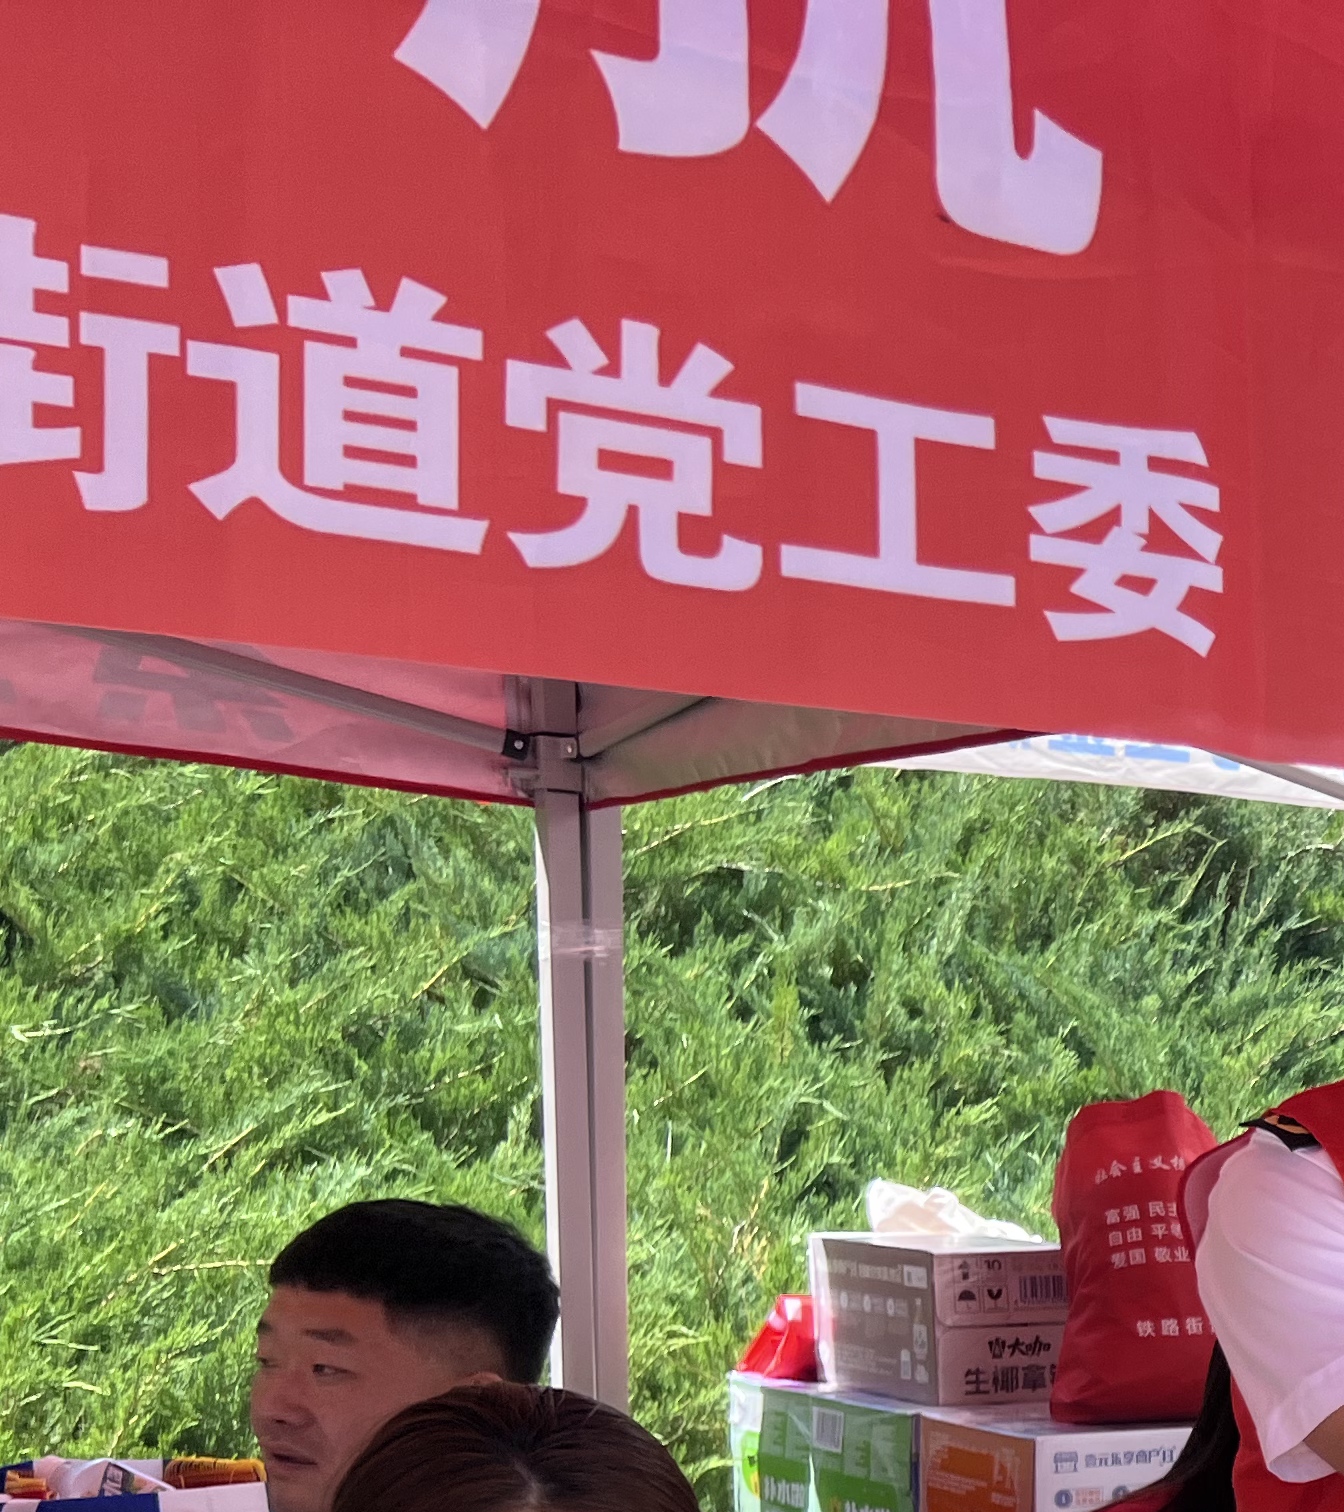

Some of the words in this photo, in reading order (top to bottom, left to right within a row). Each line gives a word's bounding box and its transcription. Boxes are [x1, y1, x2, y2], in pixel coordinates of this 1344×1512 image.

[0, 214, 1225, 658] 街道党工委
[1108, 1227, 1143, 1247] 自由
[1136, 1316, 1217, 1338] 铁路街
